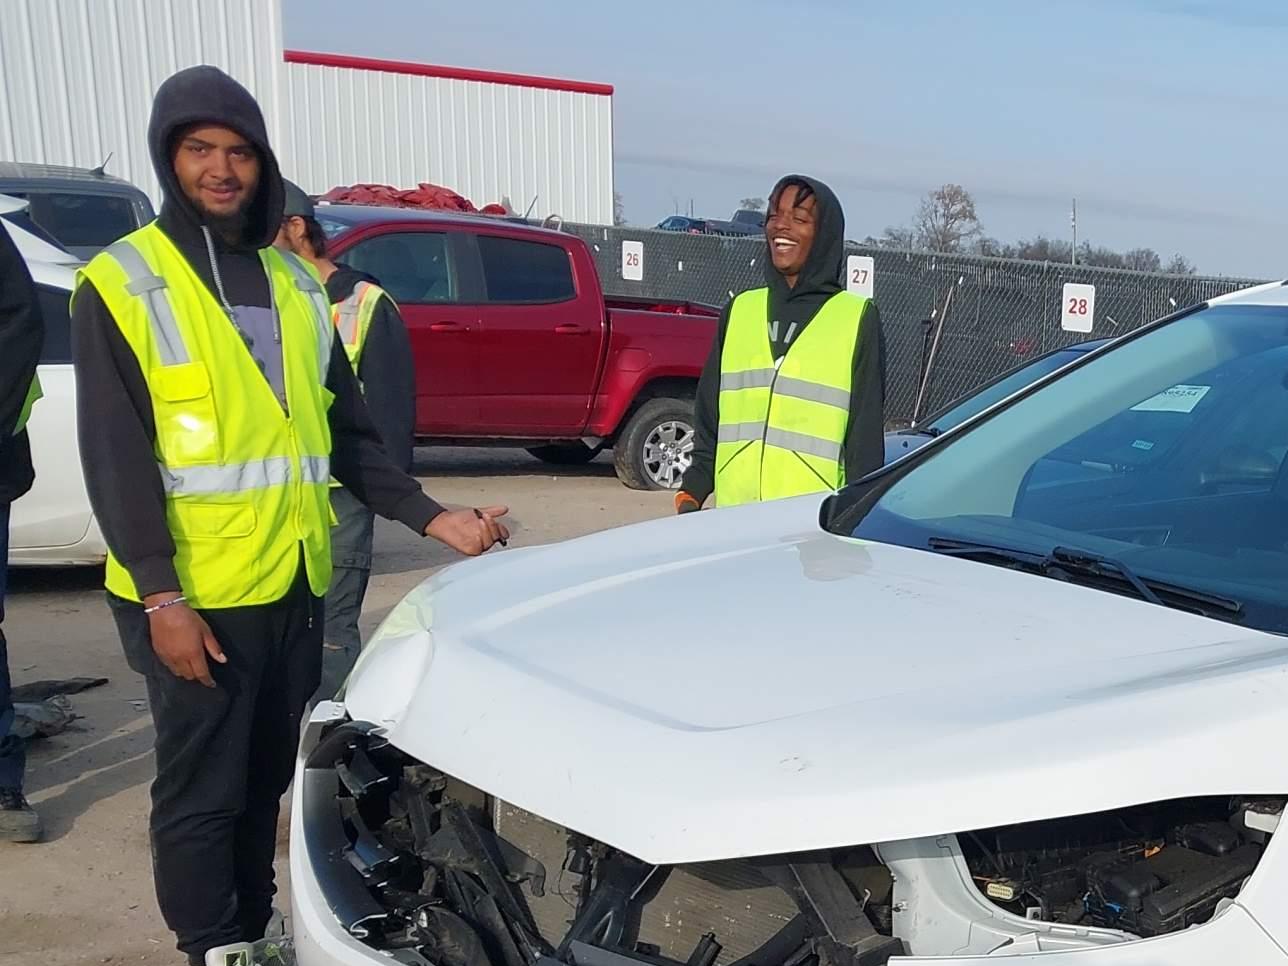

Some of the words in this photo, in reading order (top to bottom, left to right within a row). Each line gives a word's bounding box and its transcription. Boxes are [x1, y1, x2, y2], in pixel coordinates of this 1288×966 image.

[626, 253, 639, 266] 26
[852, 269, 868, 284] 27
[1069, 298, 1087, 315] 28
